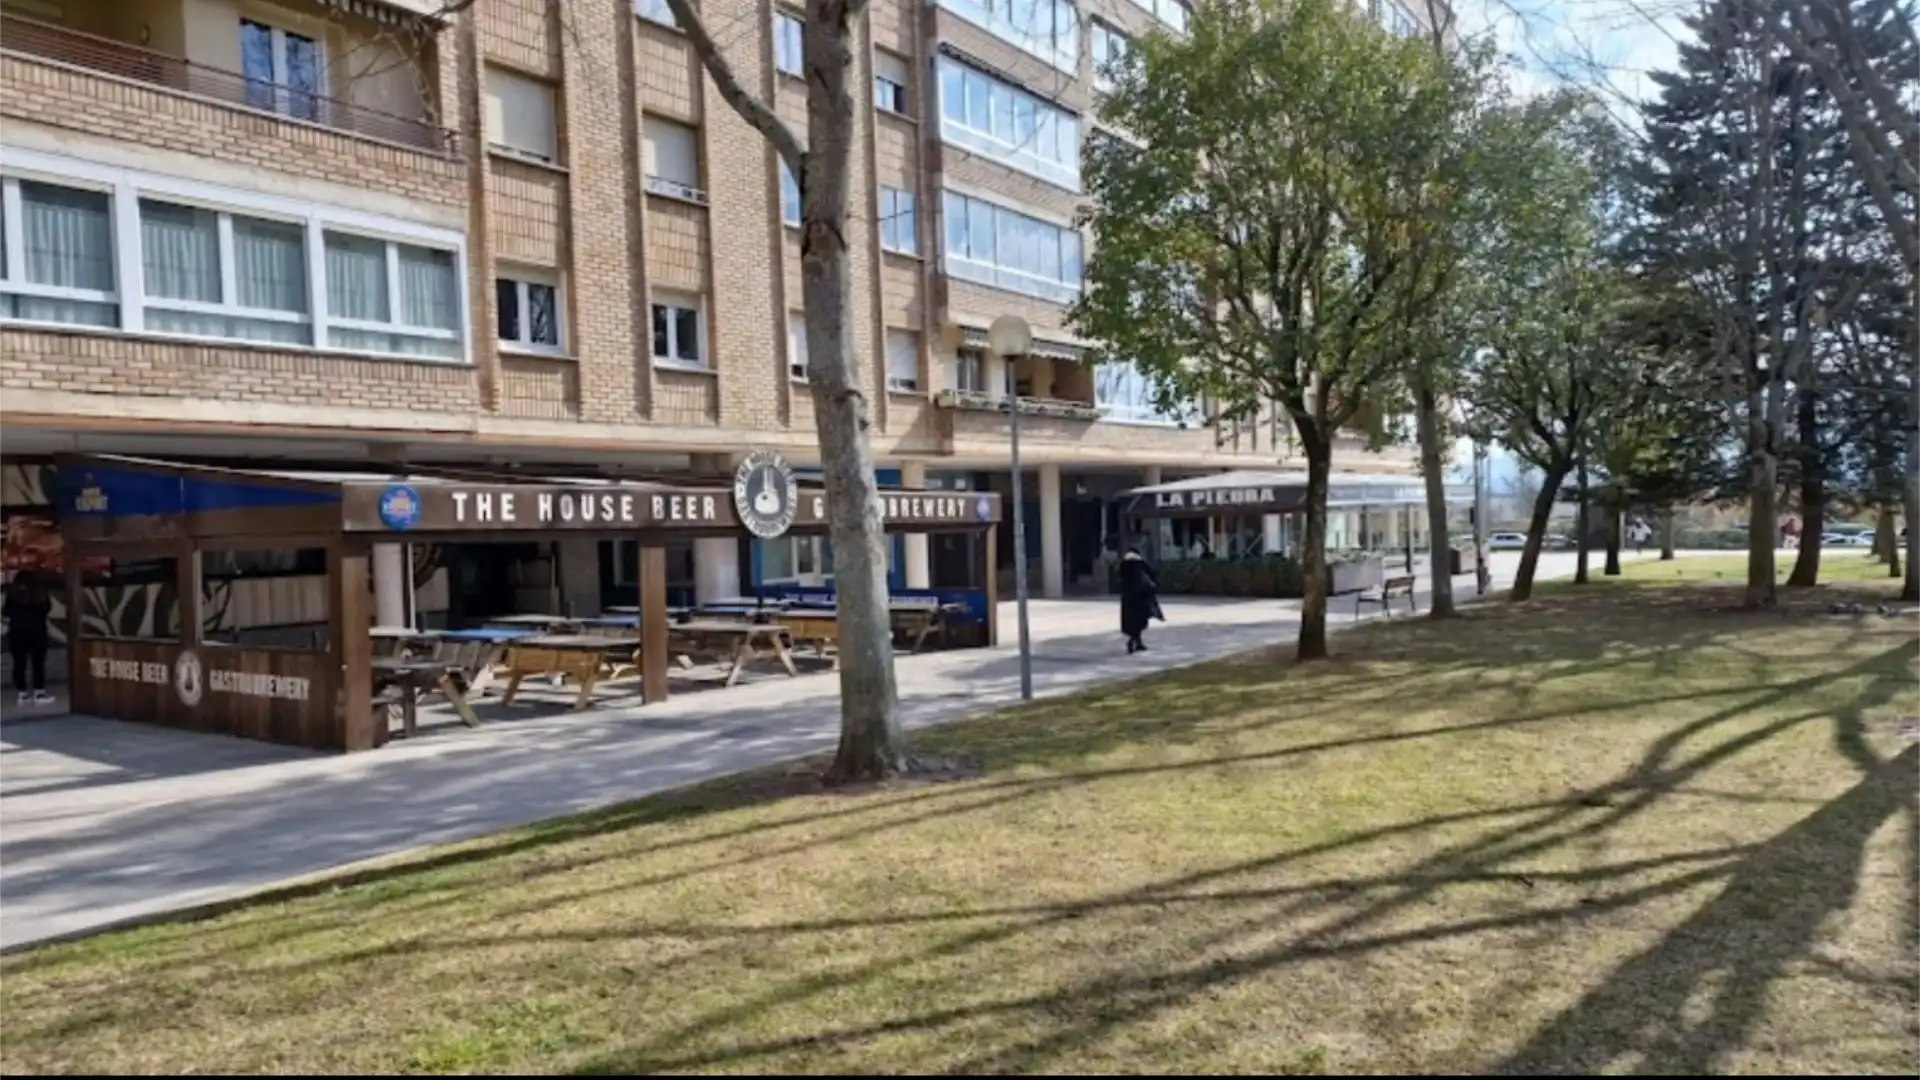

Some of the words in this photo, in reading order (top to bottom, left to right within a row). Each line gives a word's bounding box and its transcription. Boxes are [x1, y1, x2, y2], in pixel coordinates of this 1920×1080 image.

[452, 493, 516, 521] THE
[538, 493, 634, 521] HOUSE
[651, 496, 717, 520] BEER
[1156, 492, 1185, 507] LA
